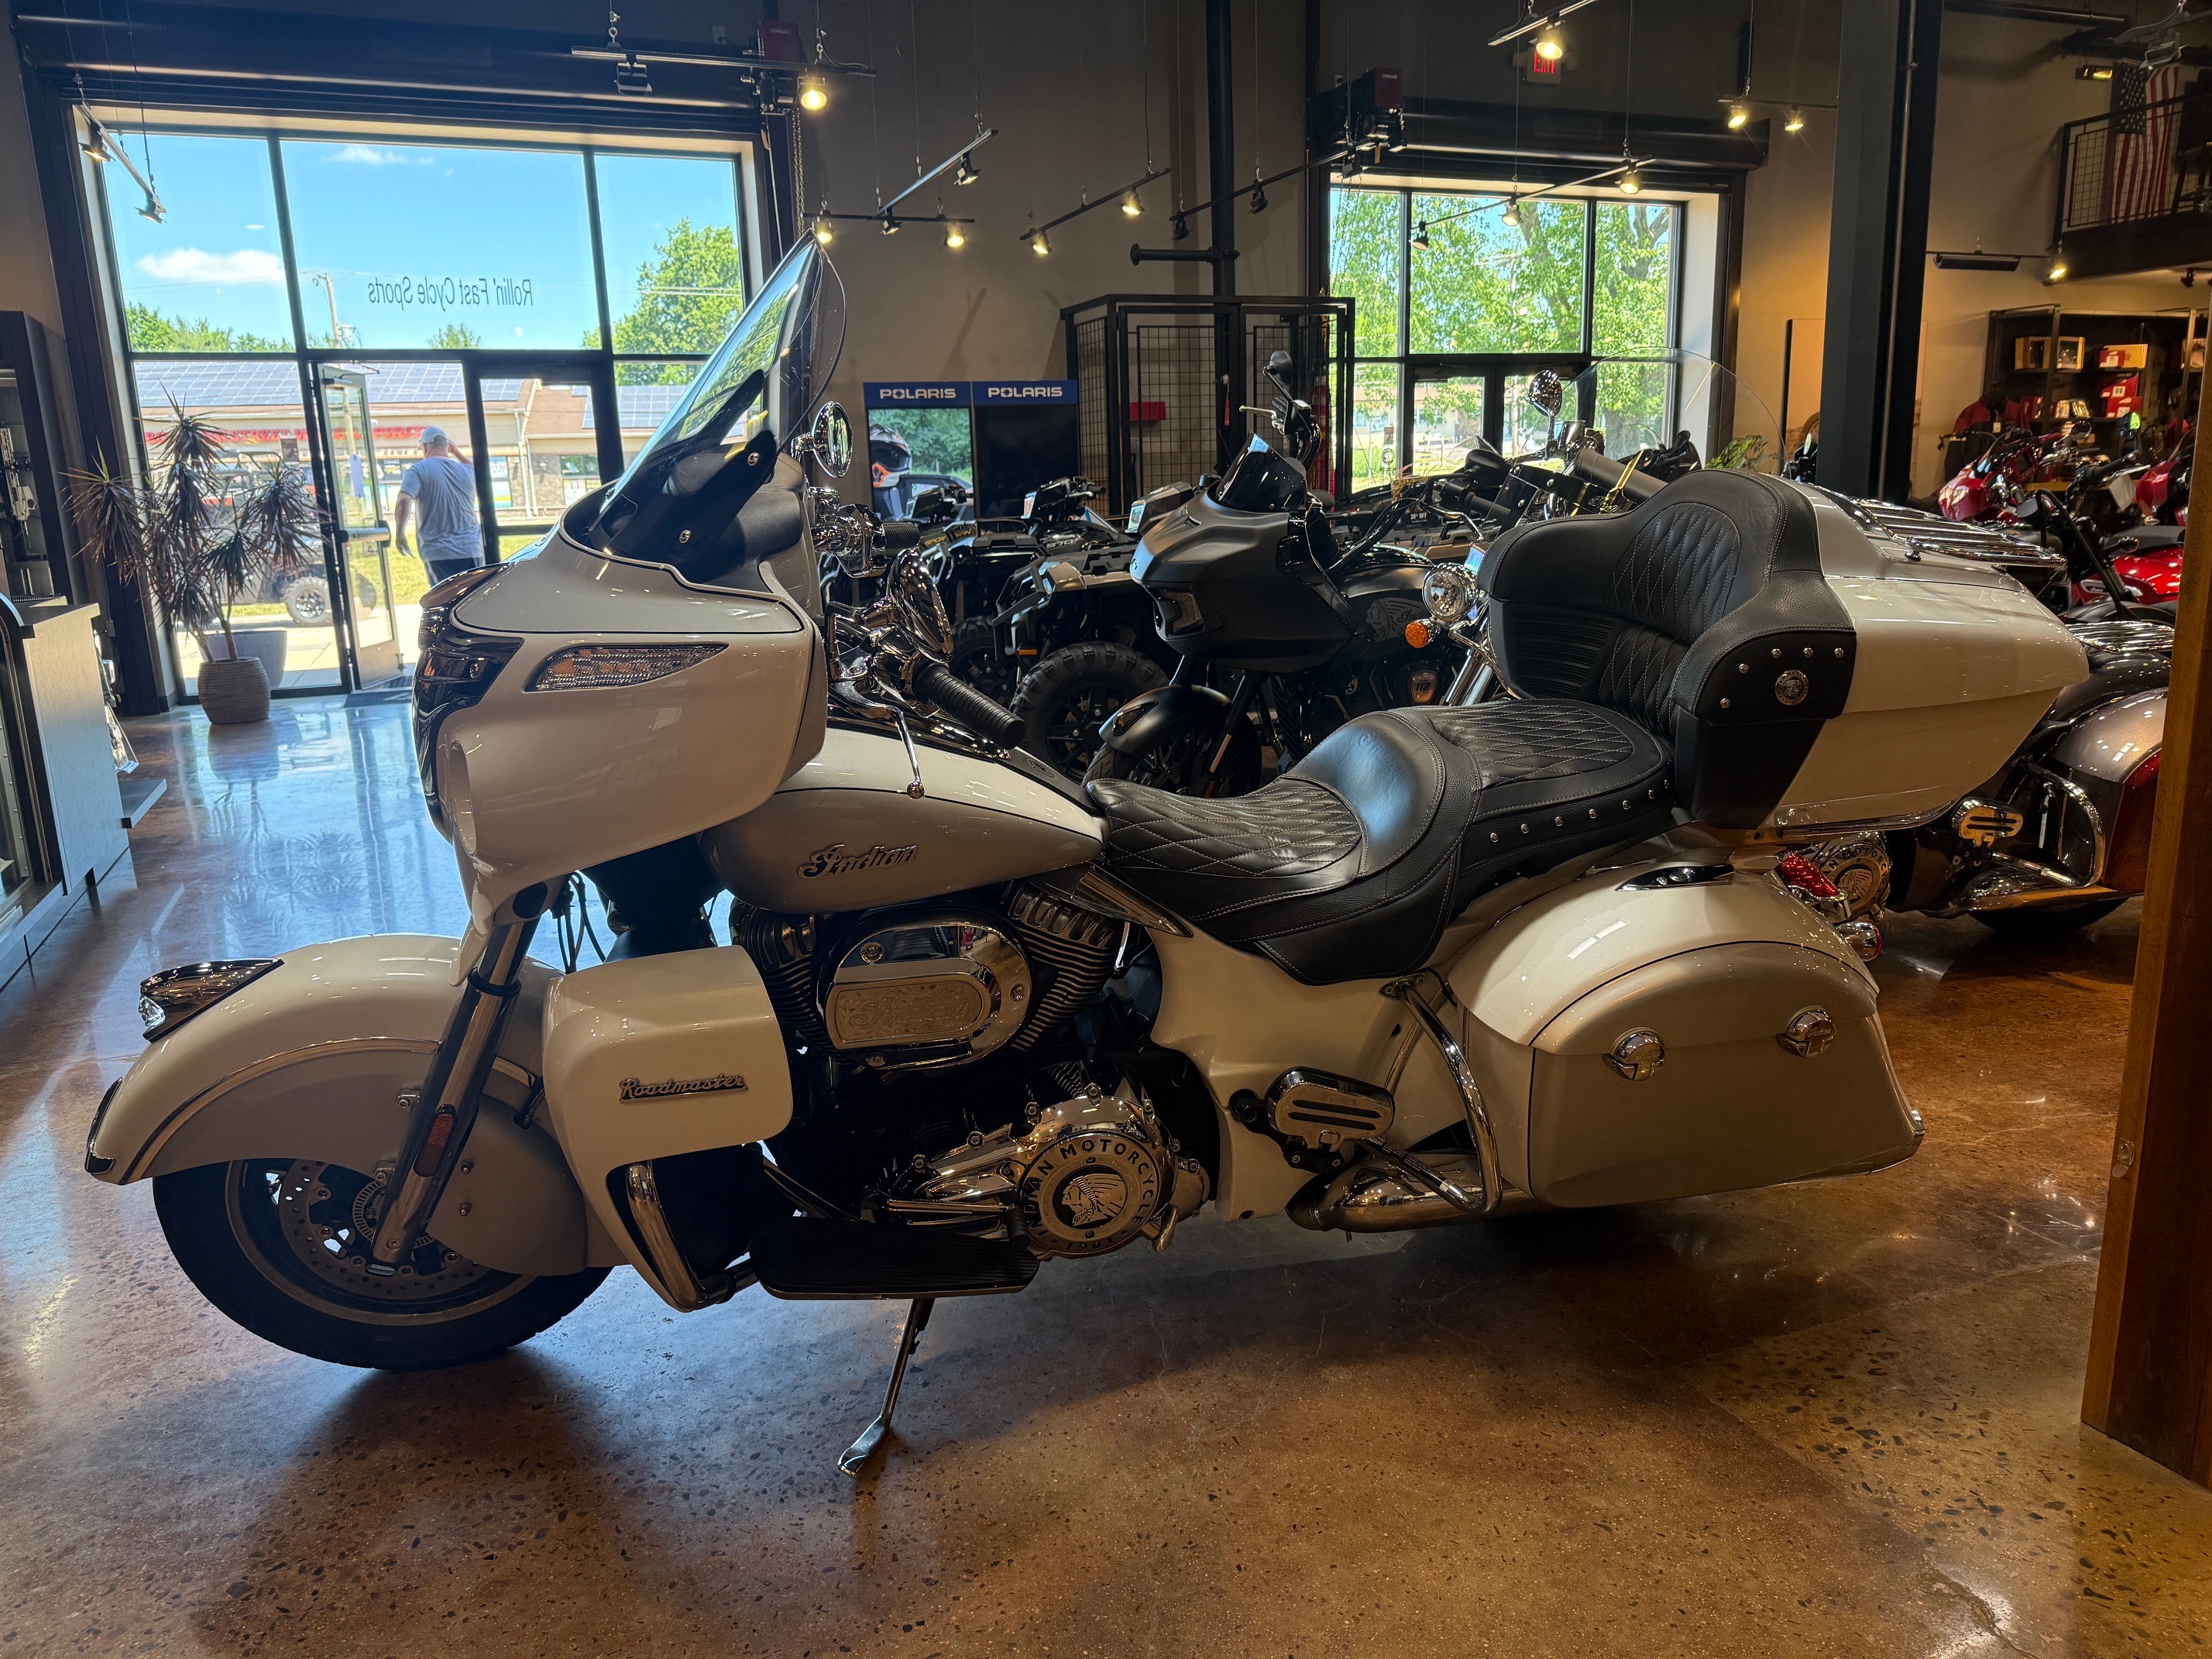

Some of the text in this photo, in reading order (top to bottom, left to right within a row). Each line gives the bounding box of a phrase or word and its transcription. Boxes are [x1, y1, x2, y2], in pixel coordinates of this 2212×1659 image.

[879, 388, 957, 400] POLARIS
[988, 386, 1063, 398] POLARIS
[1416, 682, 1431, 692] 112
[798, 843, 919, 880] Indian
[849, 997, 972, 1029] Indian
[619, 1073, 747, 1103] Roadmaster
[1023, 1139, 1156, 1237] INDIAN MOTORCYCLE
[1065, 1237, 1114, 1251] 1901
